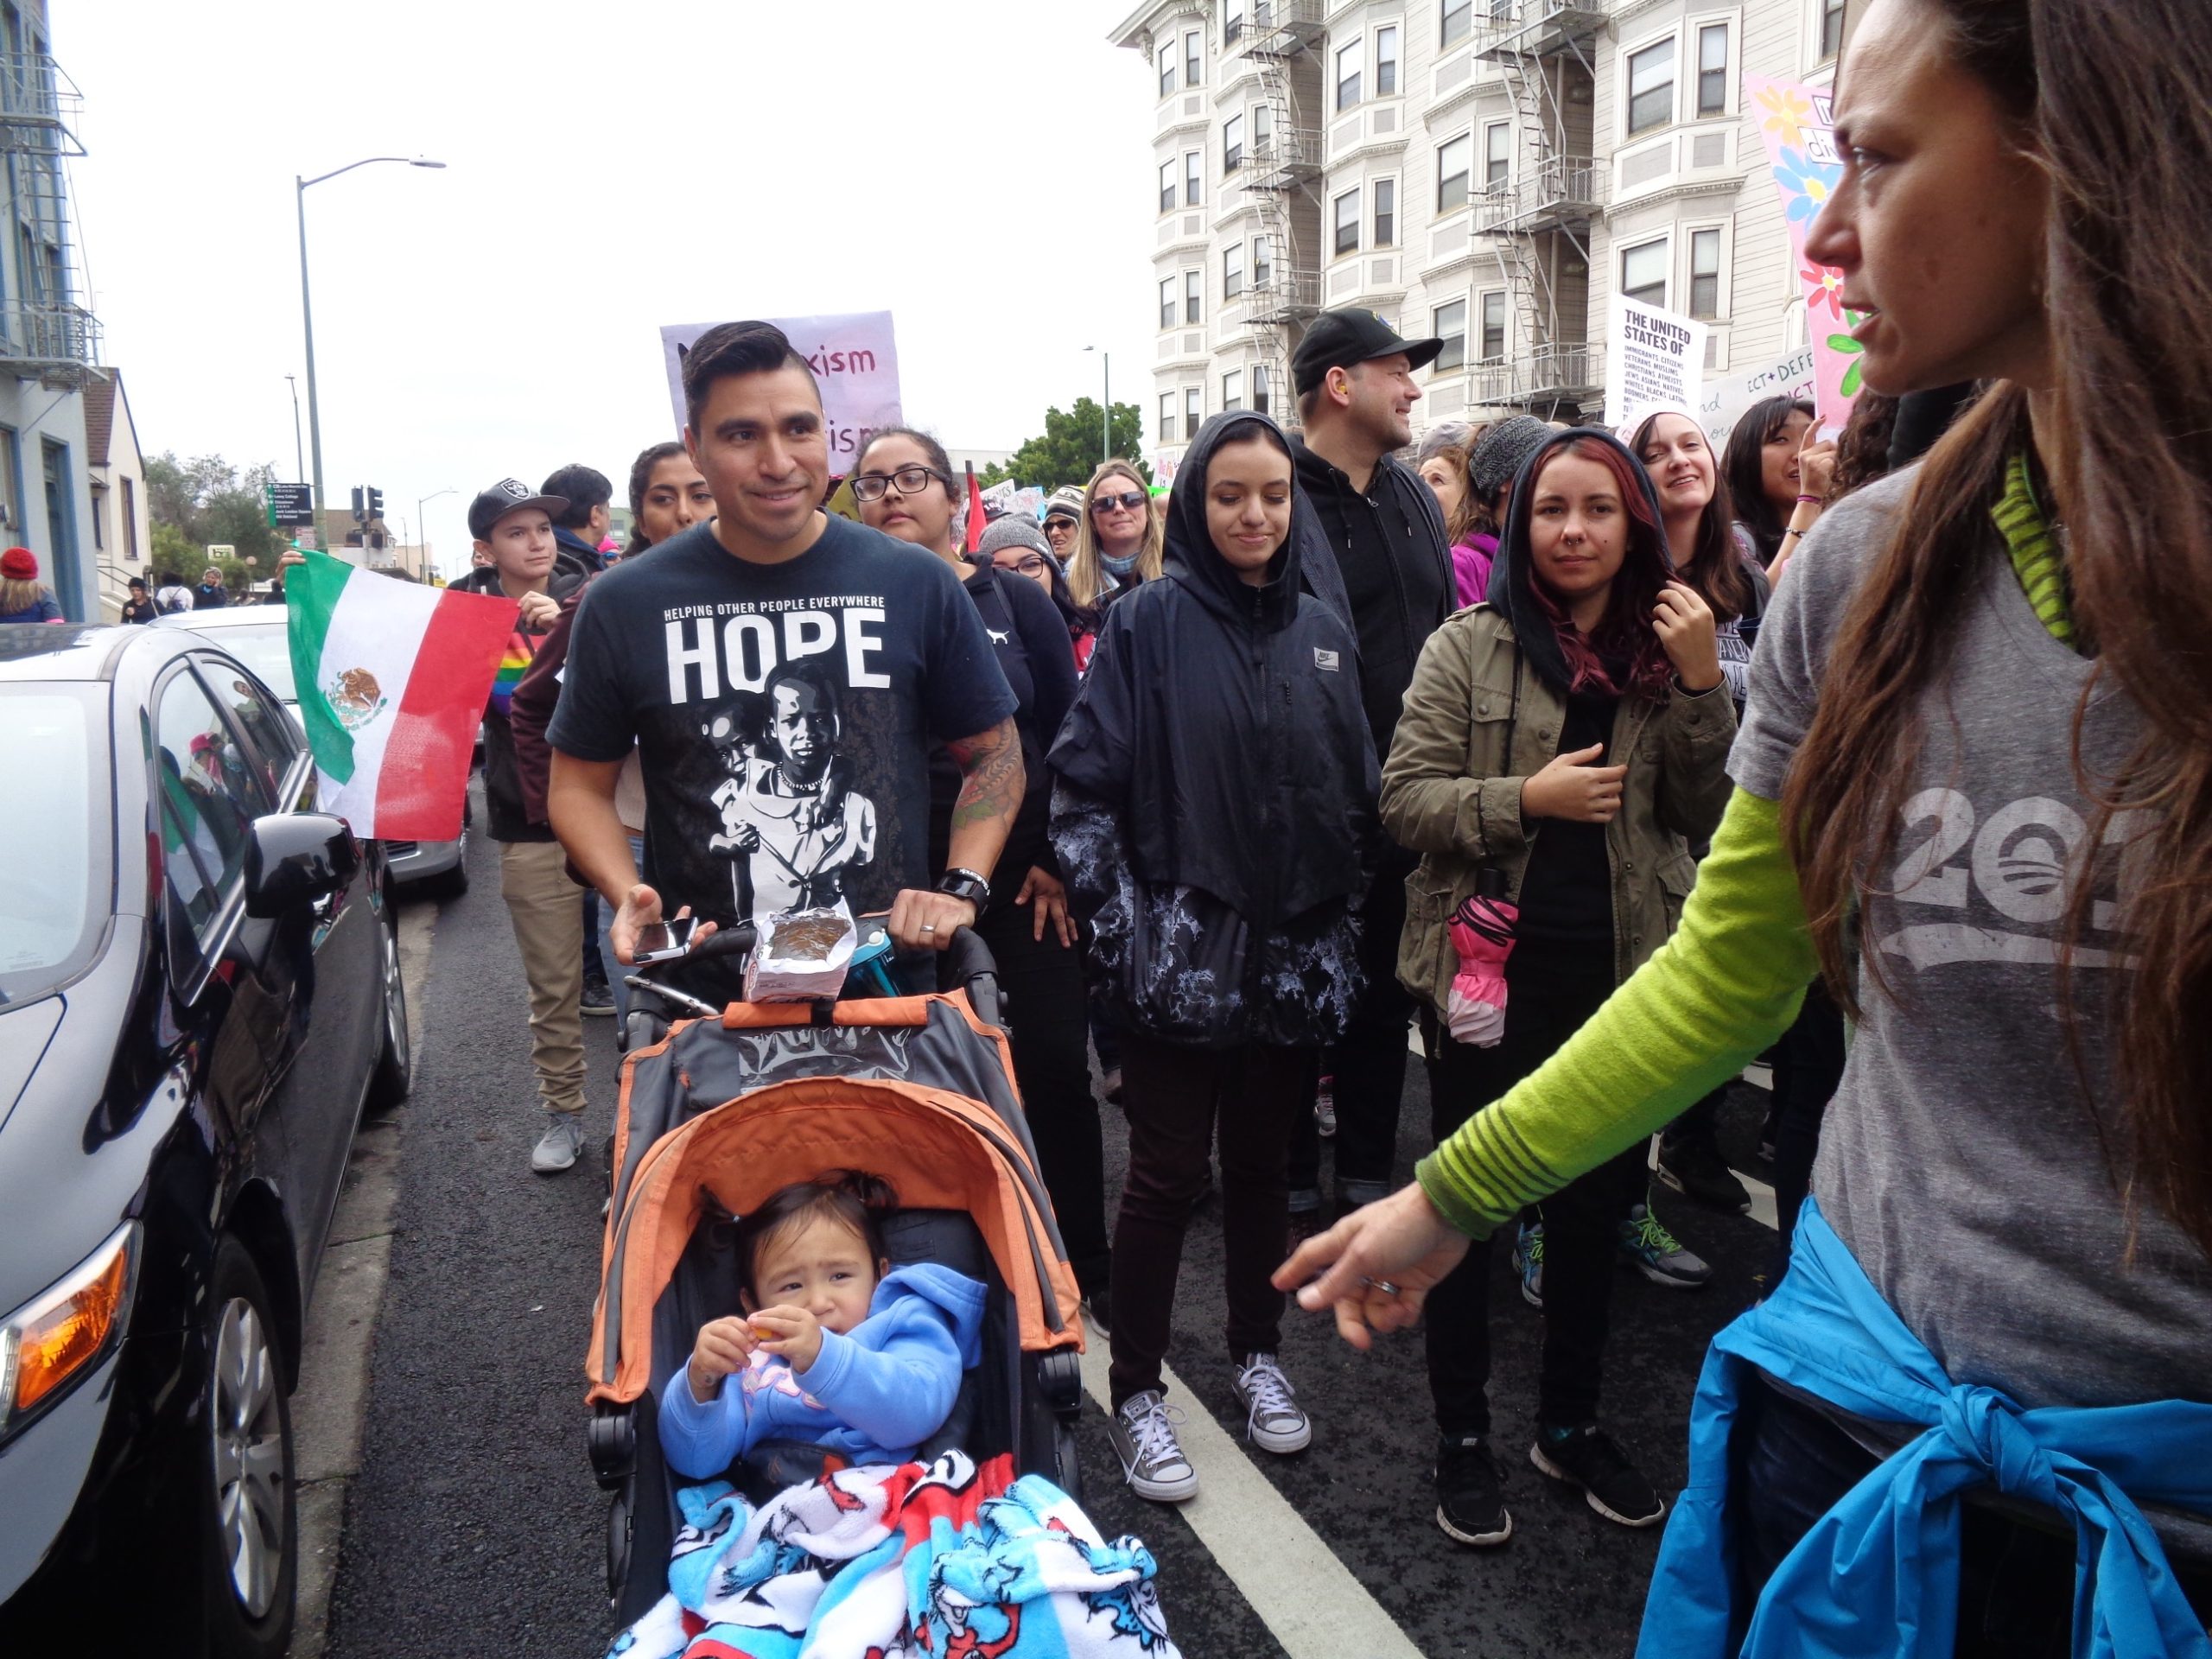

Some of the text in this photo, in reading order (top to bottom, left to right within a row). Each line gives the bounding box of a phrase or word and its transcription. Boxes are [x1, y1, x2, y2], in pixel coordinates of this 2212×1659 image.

[1624, 308, 1691, 345] THE UNITED
[1624, 325, 1684, 356] STATES OF
[1624, 345, 1684, 371] IMMIGRANTS CITIZENS
[1624, 353, 1679, 377] VETERANS MUSLIMS
[1624, 362, 1682, 387] CHRISTIANS ATHEISTS
[1624, 371, 1684, 396] JEWS ASIANS NATIVES
[1624, 379, 1644, 391] WHITES
[1646, 385, 1667, 398] BLACKS
[1624, 386, 1649, 402] BOOMERS
[664, 595, 886, 621] HELPING OTHER PEOPLE EVERYWHERE
[665, 607, 891, 704] HOPE
